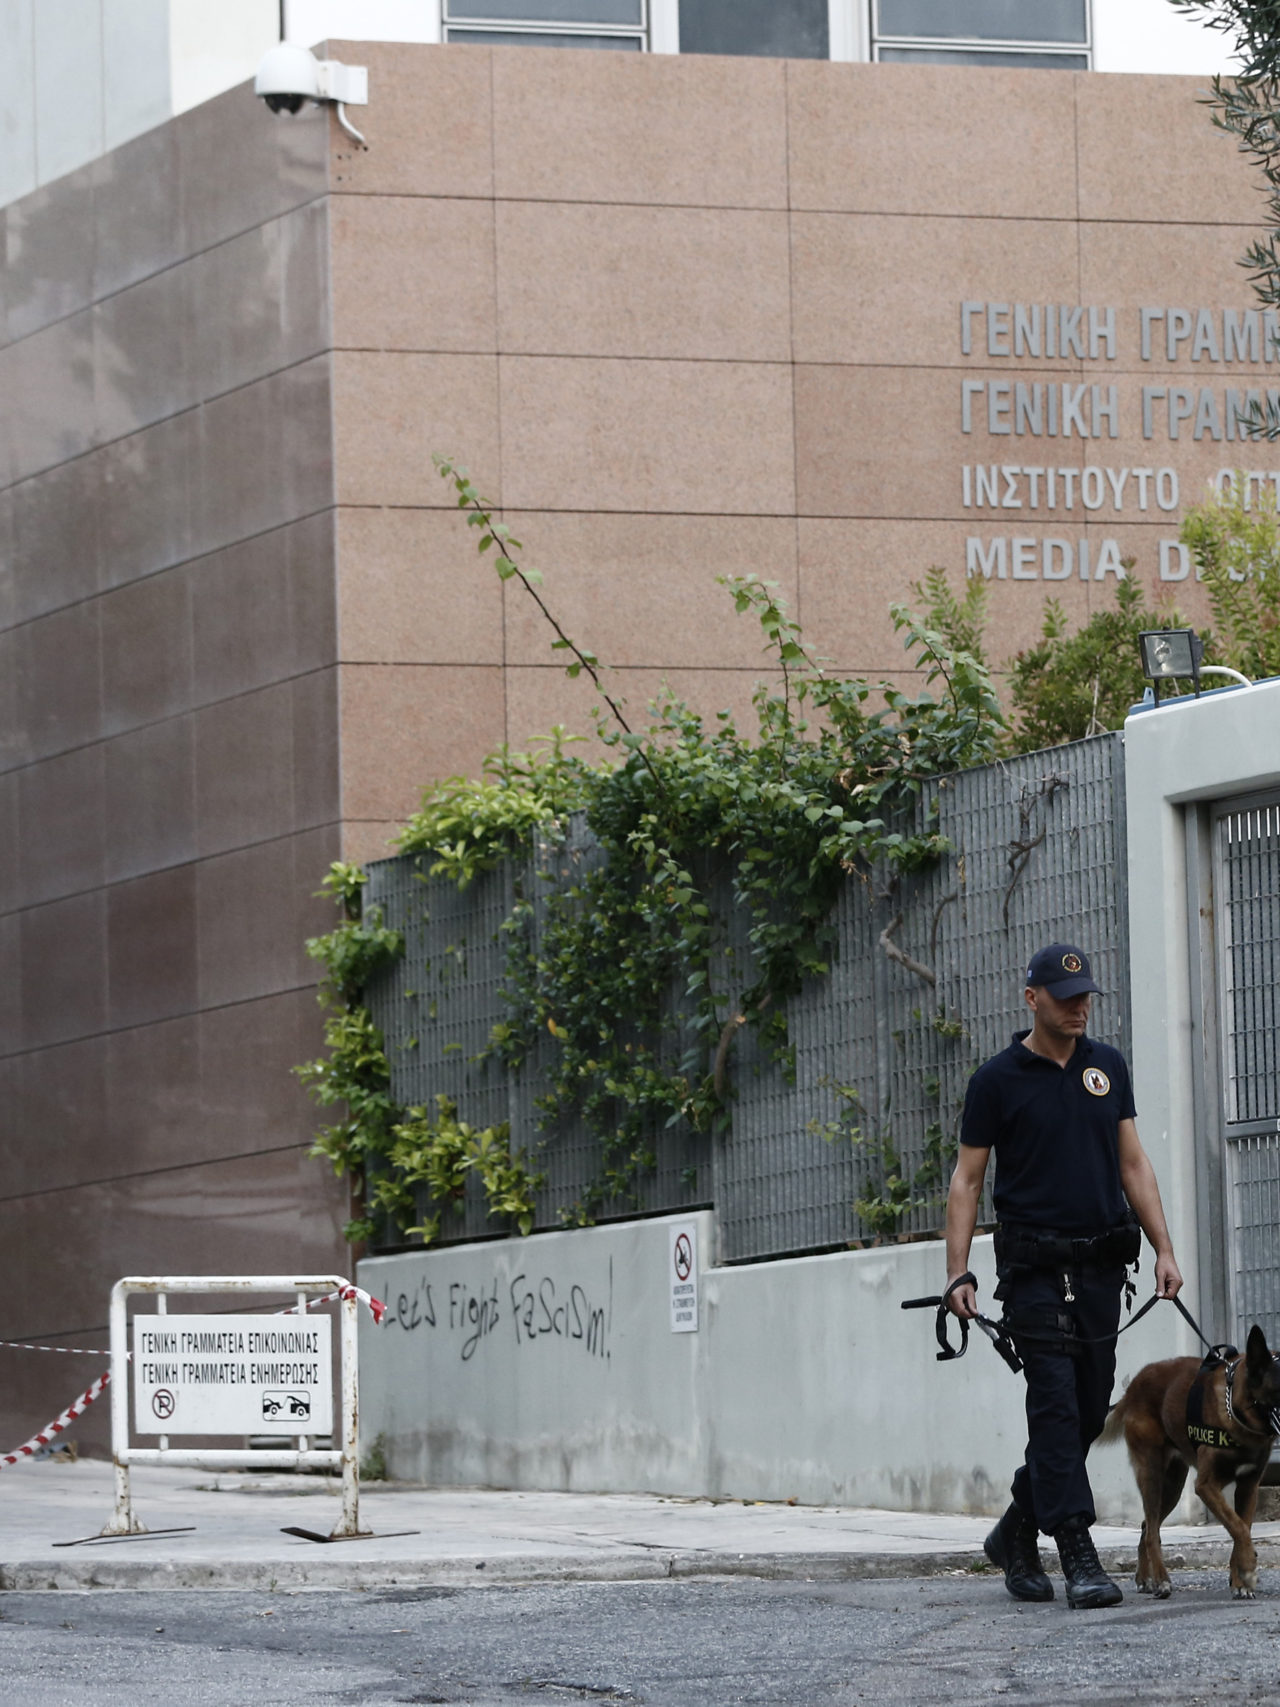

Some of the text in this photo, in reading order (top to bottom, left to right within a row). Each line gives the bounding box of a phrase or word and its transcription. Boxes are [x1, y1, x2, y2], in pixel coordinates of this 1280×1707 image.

[961, 301, 1116, 361] ΓΕΝΙΚΗ
[961, 380, 1119, 439] ΓΕΝΙΚΗ
[962, 464, 1179, 512] ΙΝΣΤΙΤΟΥΤΟ
[966, 537, 1127, 582] MEDIA
[142, 1333, 318, 1353] ΓΕΝΙΚΗ ΓΡΑΜΜΑΤΕΙΑ ΕΠΙΚΟΙΝΩΝΙΑΣ
[143, 1363, 318, 1384] ΓΕΝΙΚΗ ΓΡΑΜΜΑΤΕΙΑ ΕΝΗΜΕΡΩΣΗΣ
